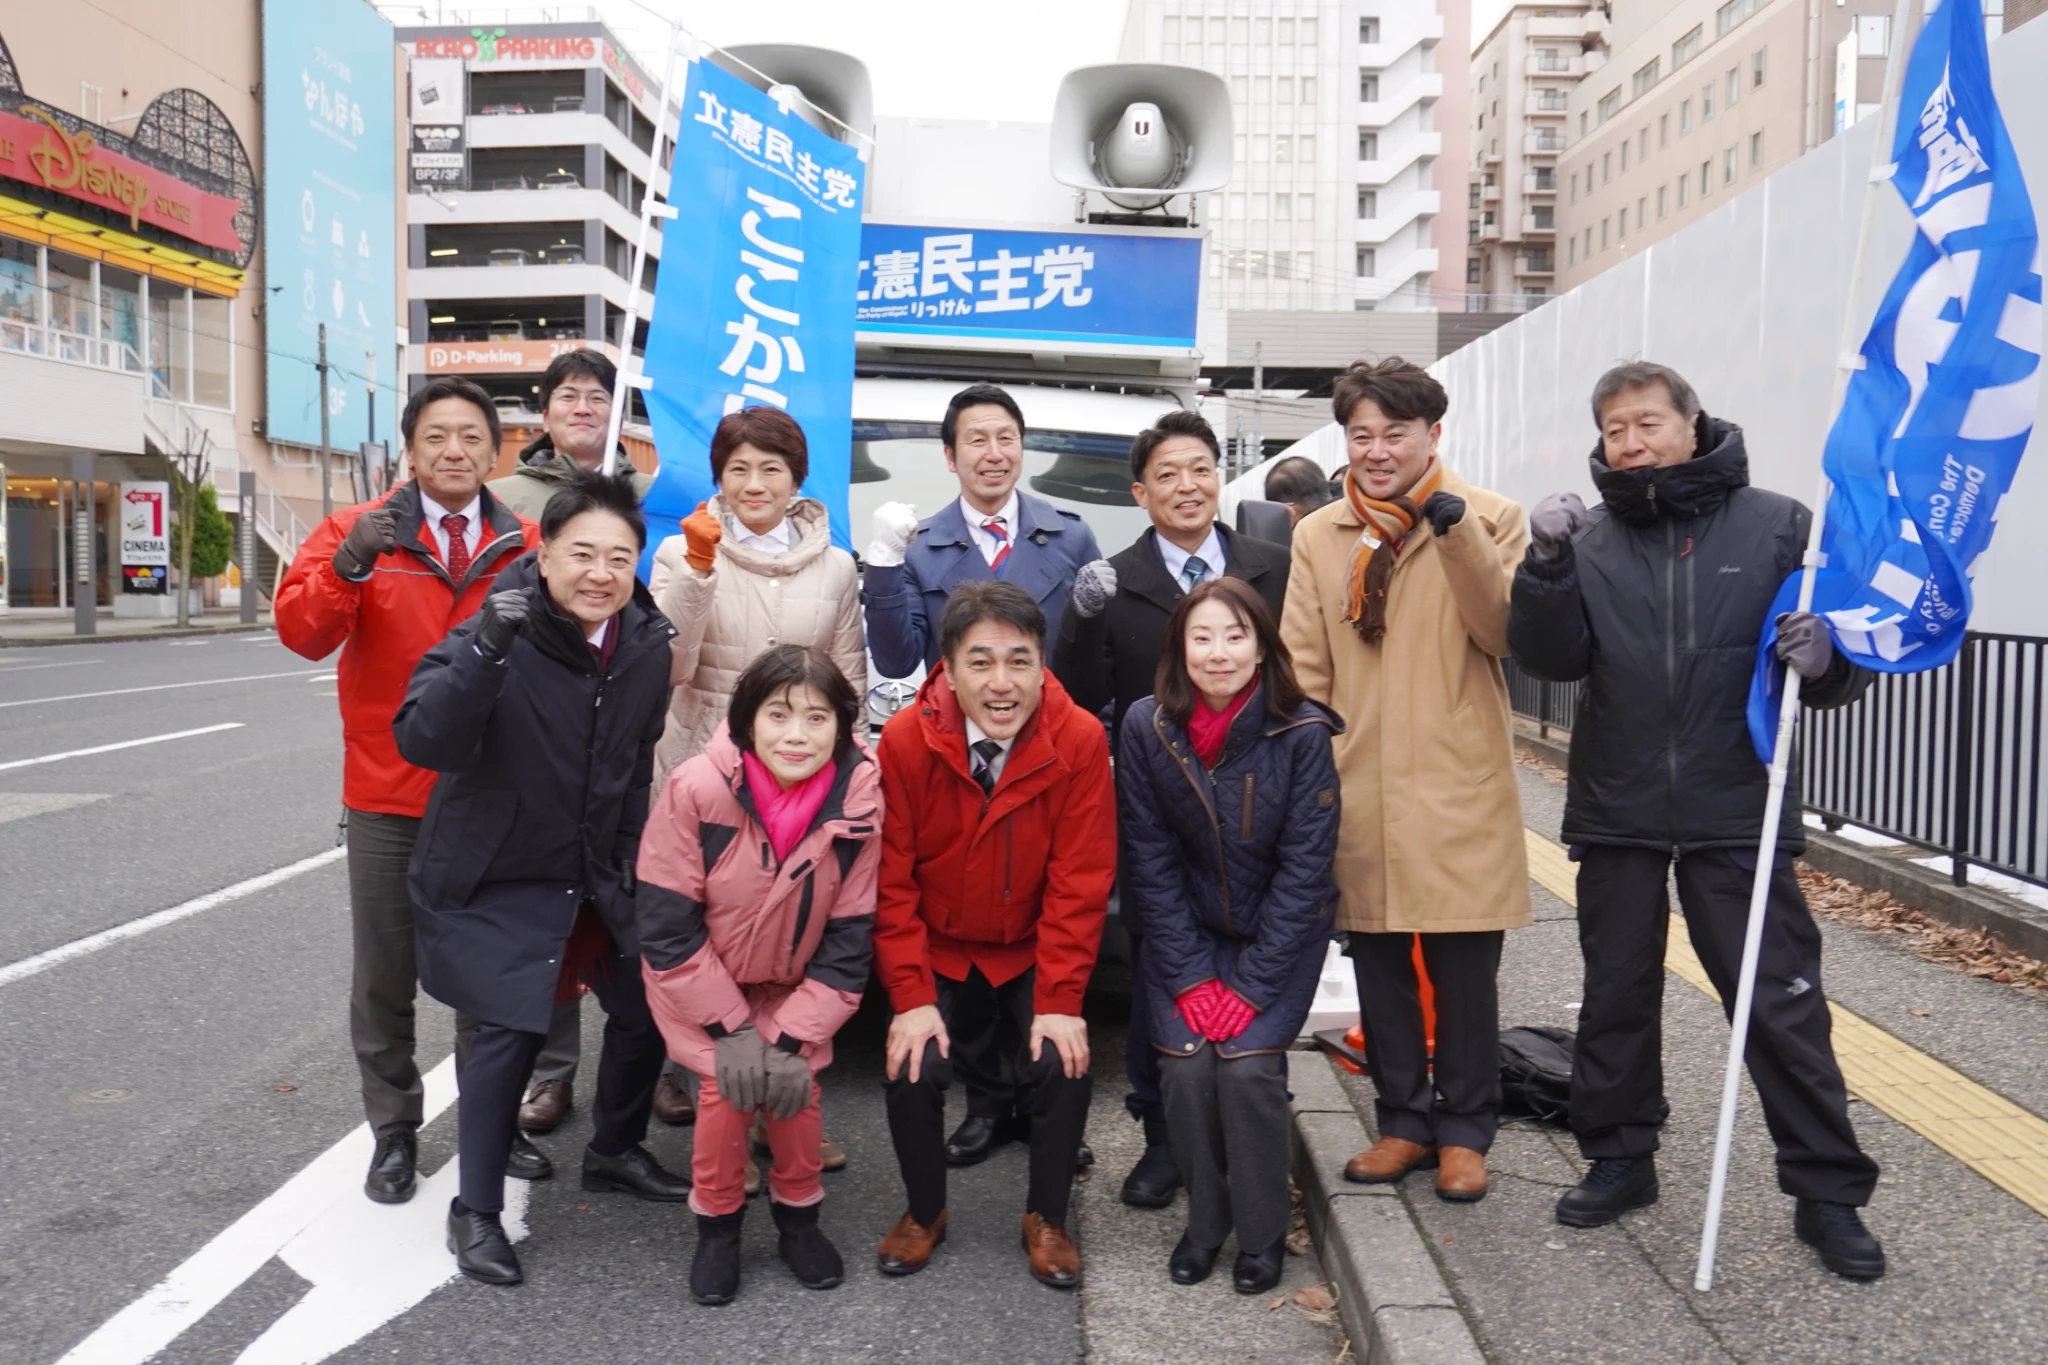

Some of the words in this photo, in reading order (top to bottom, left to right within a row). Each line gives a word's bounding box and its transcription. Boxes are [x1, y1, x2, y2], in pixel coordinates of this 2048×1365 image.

[496, 37, 595, 60] PARKING
[1135, 121, 1149, 136] U
[694, 90, 857, 208] 立憲民主党
[415, 168, 461, 181] BP2/3F
[911, 298, 972, 318] りっけん
[450, 350, 523, 366] D-Parking
[124, 541, 165, 552] CINEMA
